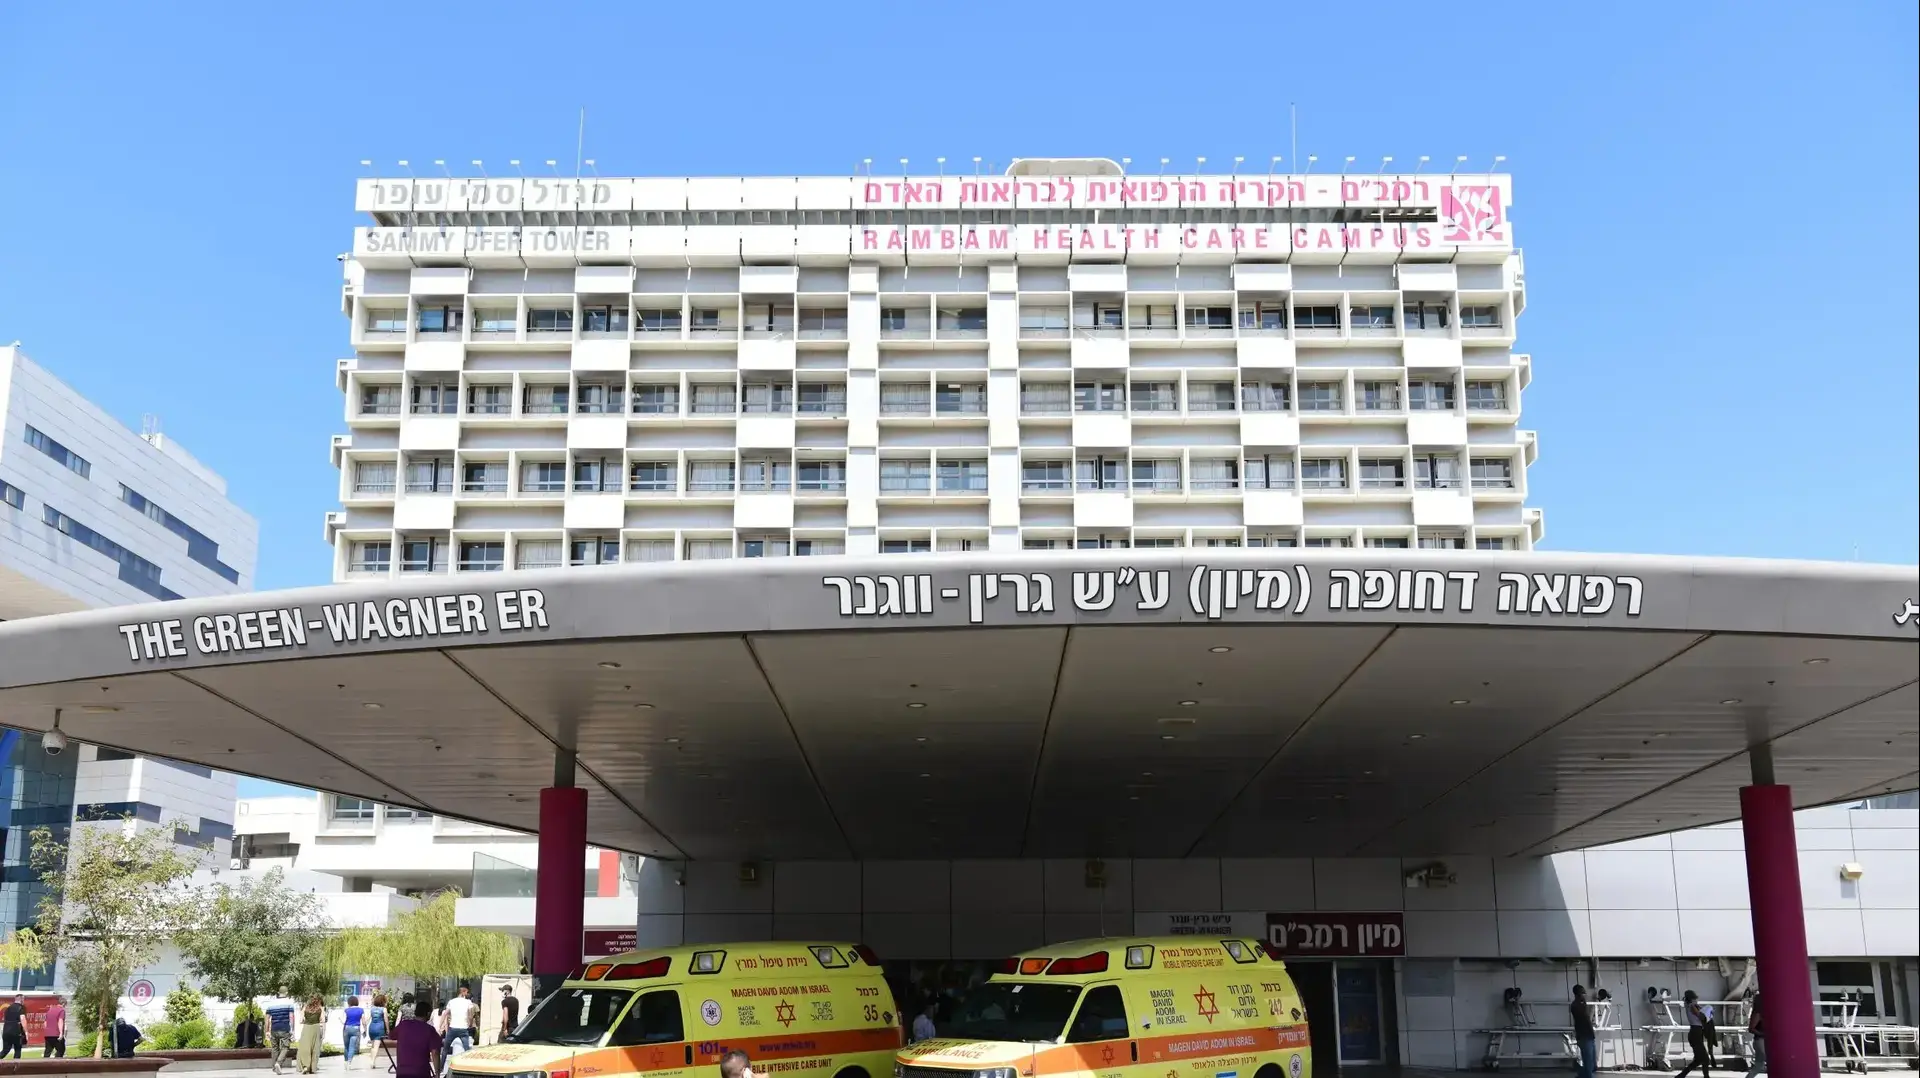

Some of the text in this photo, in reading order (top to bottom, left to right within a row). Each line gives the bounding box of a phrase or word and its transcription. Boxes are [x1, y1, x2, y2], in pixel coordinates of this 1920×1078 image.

[370, 179, 611, 206] מגדל סמי עופר
[864, 182, 943, 203] האדם
[961, 176, 1075, 203] לבריאות
[1089, 180, 1206, 203] הרפואית
[1219, 180, 1305, 206] הקריה
[366, 231, 611, 252] SAMMY OFER TOWER
[864, 228, 1432, 250] RAMBAM HEALTH CARE CAMPUS
[1329, 570, 1480, 612] דחופה
[1497, 572, 1643, 616] רפואה
[119, 589, 549, 660] THE GREEN-WAGNER ER
[1357, 923, 1401, 954] מיון
[1160, 946, 1223, 960] ניידת טיפול נמרץ
[735, 954, 808, 971] ניידת טיפול נמרץ
[731, 984, 831, 998] MAGEN DAVID ADOM IN ISRAEL
[1150, 989, 1175, 998] MAGEN
[1226, 984, 1253, 995] מגן דוד
[1152, 999, 1174, 1007] DAVID
[1238, 996, 1257, 1006] אדום
[1268, 998, 1284, 1016] 242
[863, 1004, 879, 1022] 35
[1155, 1007, 1176, 1017] ADOM
[1156, 1015, 1188, 1026] IN ISRAEL
[1231, 1007, 1259, 1020] בישראל
[698, 1041, 720, 1056] 101
[1168, 1035, 1256, 1053] MAGEN DAVID ADOM IN ISRAEL
[909, 1048, 984, 1060] AMBULANCE
[751, 1058, 833, 1074] BILE INTENSIVE CARE UNIT
